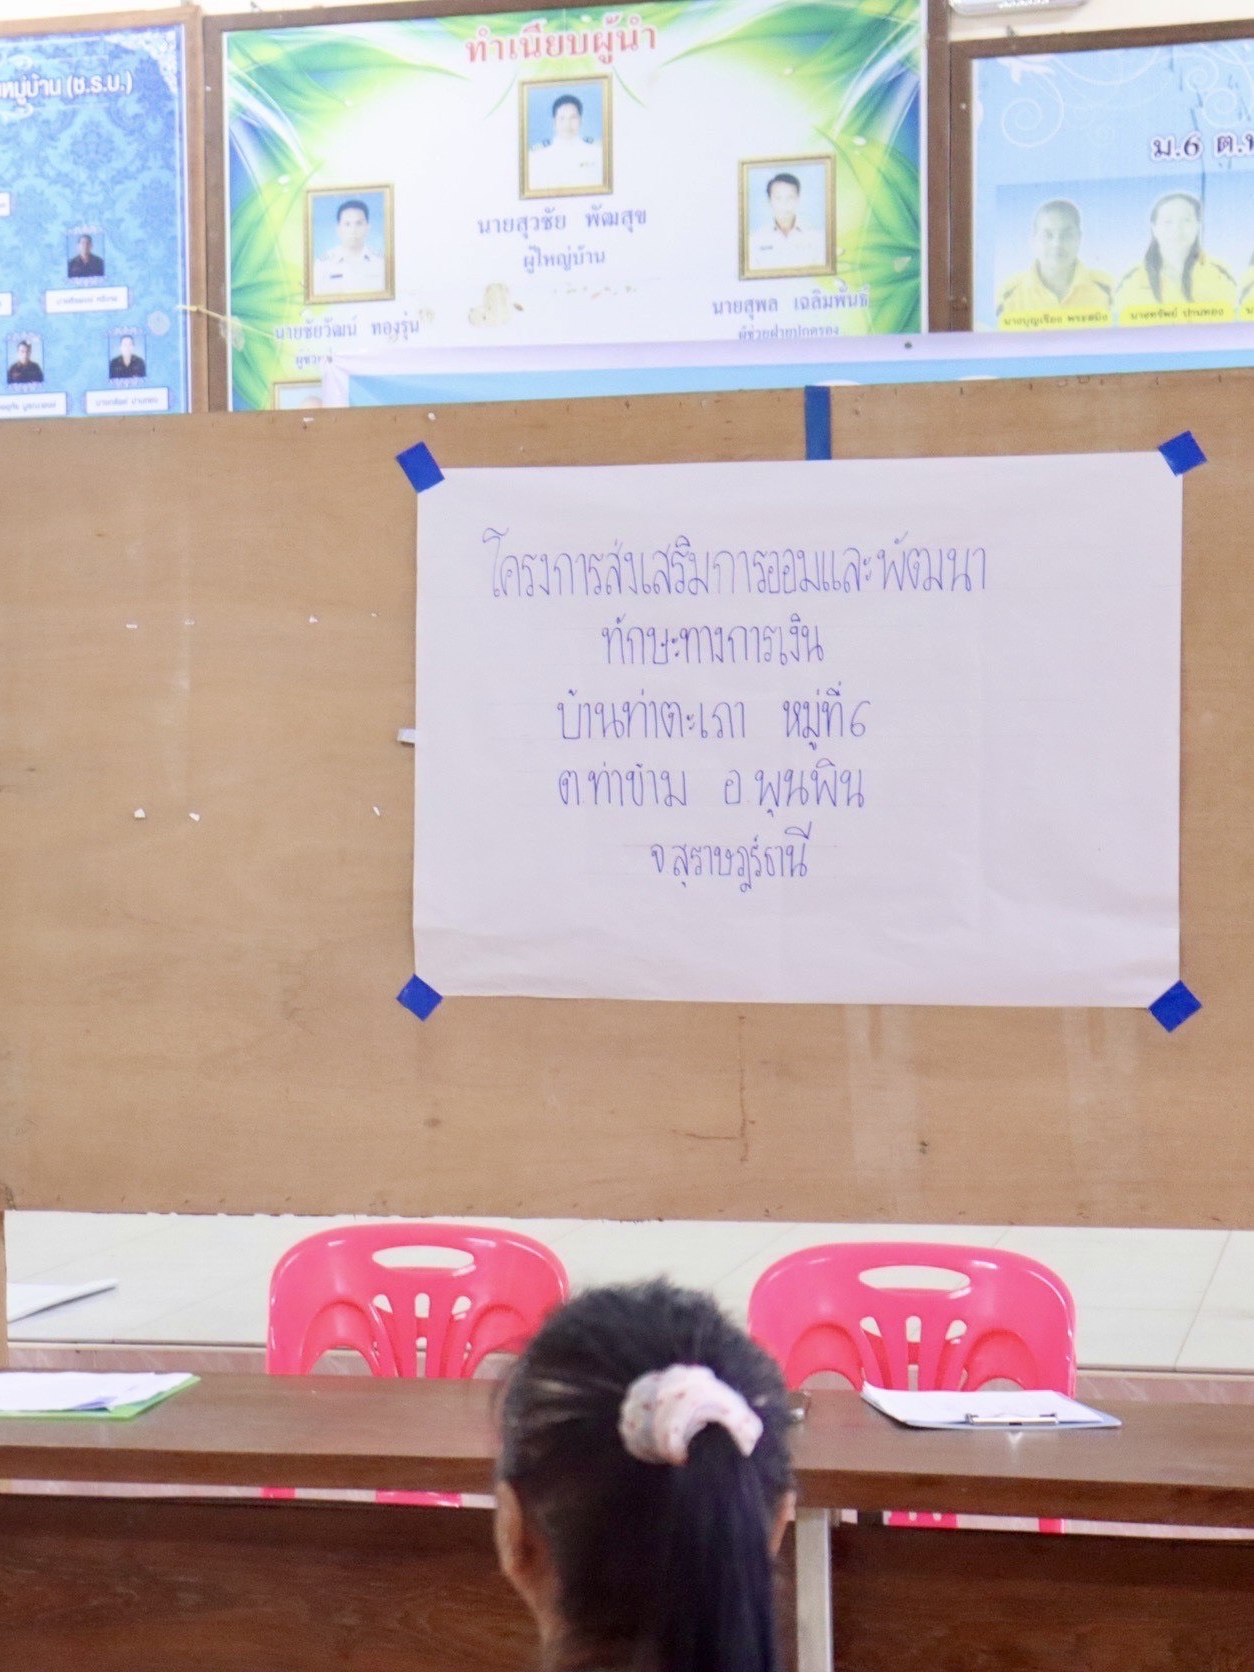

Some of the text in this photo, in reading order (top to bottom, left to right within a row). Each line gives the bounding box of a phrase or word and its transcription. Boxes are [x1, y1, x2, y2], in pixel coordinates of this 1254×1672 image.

[465, 21, 656, 66] ทำเนียบผู้นำ
[67, 70, 132, 97] (ช.ร.บ.)
[1153, 134, 1201, 157] ม.6
[476, 204, 647, 238] นายสุวชัย พัฒสุข
[523, 245, 605, 275] ผู้ใหญ่บ้าน
[712, 284, 869, 320] นายสุพล เฉลิมพันธ์
[274, 312, 419, 341] นายชัยวัฒน์ ทองรุ่น
[482, 527, 986, 597] โครงการส่งเสริมการออมและพัฒนา
[601, 613, 824, 665] ทักษะทางการเงิน
[557, 689, 745, 740] บ้านท่าตะเภา
